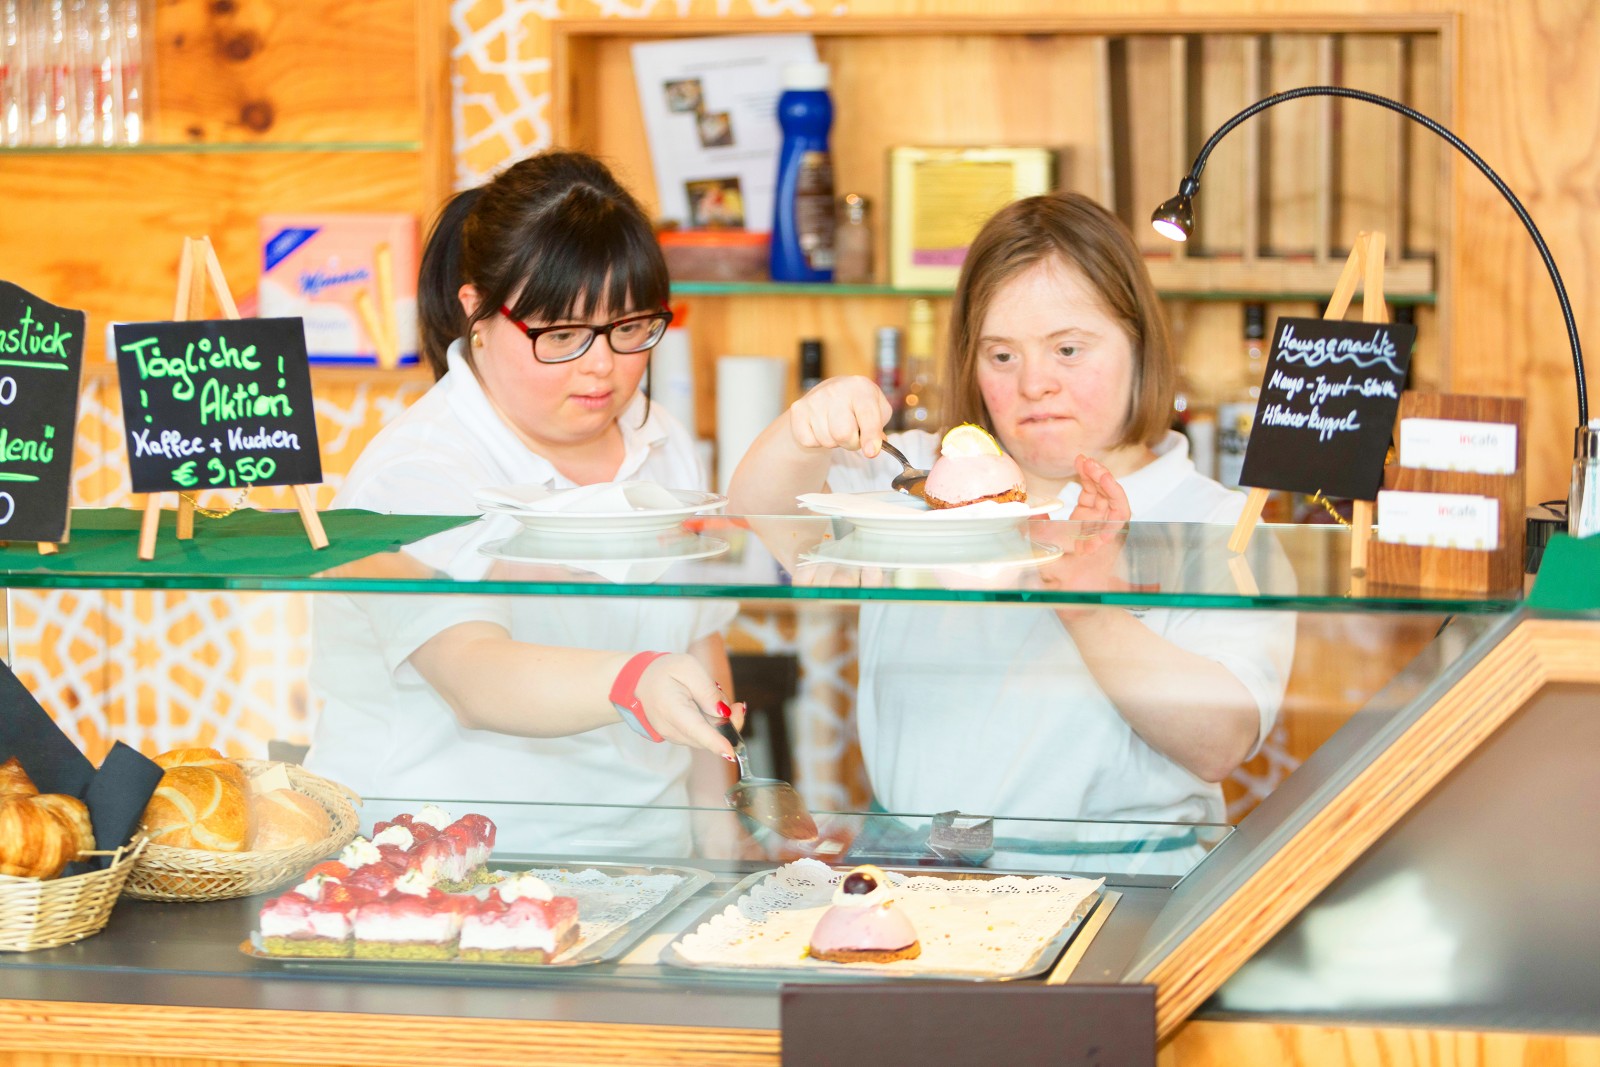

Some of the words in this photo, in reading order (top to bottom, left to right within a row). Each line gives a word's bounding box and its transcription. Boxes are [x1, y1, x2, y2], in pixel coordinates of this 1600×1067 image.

[120, 336, 262, 400] Tägliche
[200, 377, 293, 425] Aktion
[132, 428, 206, 458] Kaffee
[227, 426, 301, 451] Kuchen
[171, 460, 199, 487] €
[207, 457, 277, 487] 3,50
